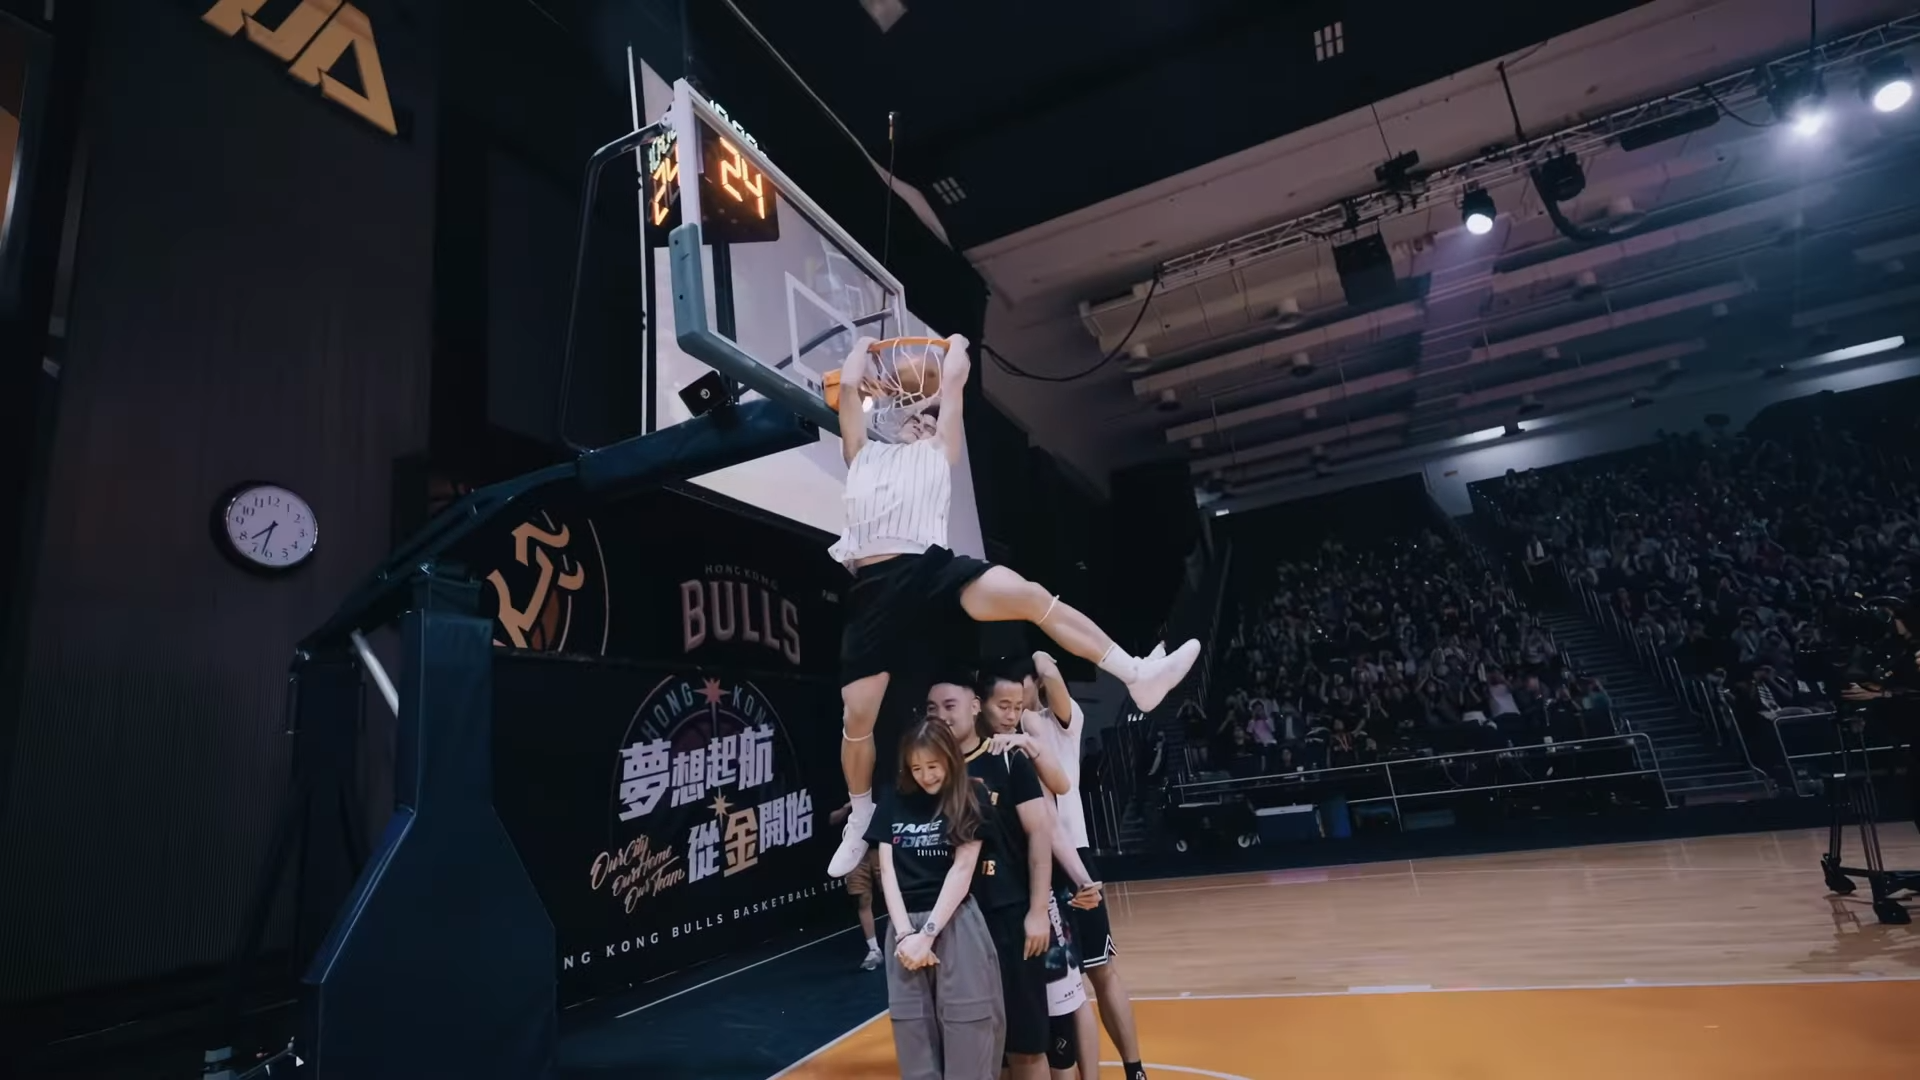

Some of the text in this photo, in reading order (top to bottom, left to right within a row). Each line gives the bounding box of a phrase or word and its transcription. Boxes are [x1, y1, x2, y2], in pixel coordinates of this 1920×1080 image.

[719, 136, 765, 219] 24
[243, 506, 255, 516] 10
[255, 497, 264, 508] 11
[268, 496, 280, 507] 12
[705, 564, 779, 592] HONG KONG
[680, 579, 801, 666] BULLS
[640, 682, 774, 739] HONG KON
[618, 723, 775, 822] 夢想起航
[687, 788, 814, 884] 從金開始
[590, 848, 624, 890] Our
[624, 855, 686, 914] Our Team
[606, 932, 659, 958] KONG
[672, 913, 723, 938] BULLS
[733, 886, 817, 920] BASKETBALL
